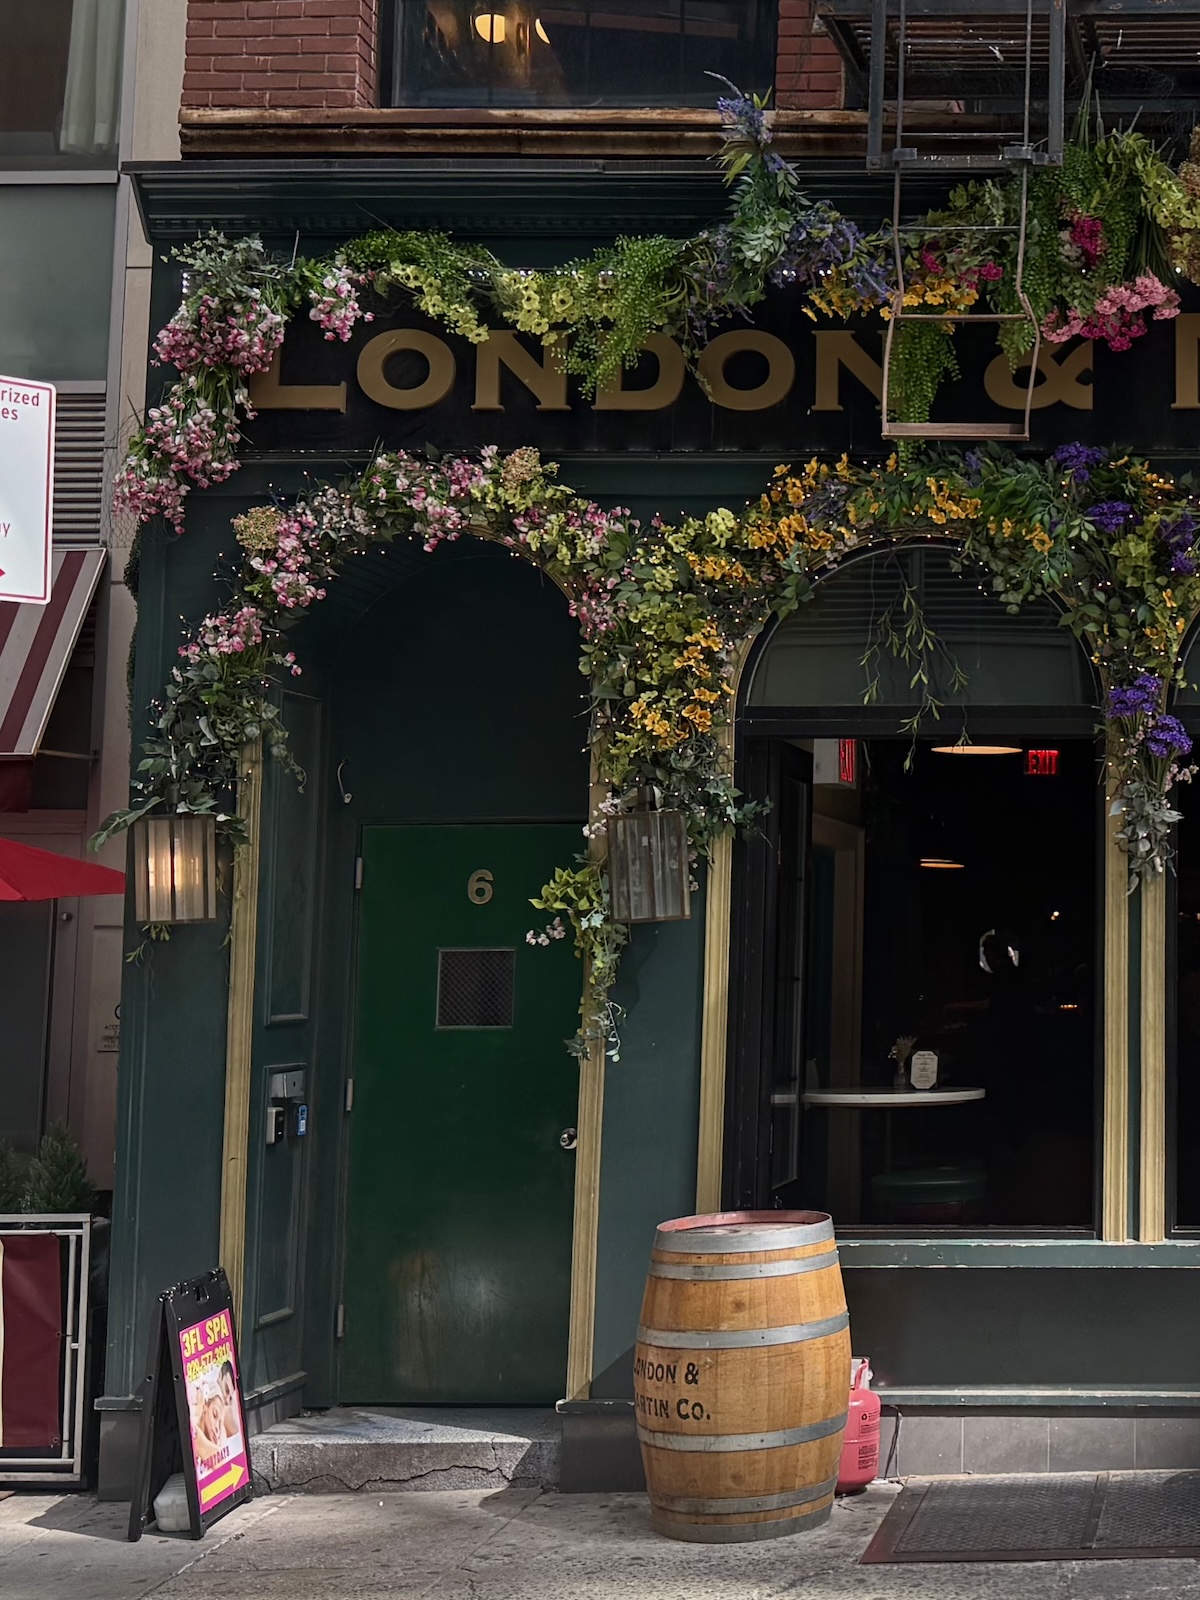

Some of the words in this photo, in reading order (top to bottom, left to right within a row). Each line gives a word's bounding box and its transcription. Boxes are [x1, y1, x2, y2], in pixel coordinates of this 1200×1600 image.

[248, 327, 899, 414] LONDON
[983, 340, 1094, 411] &
[1028, 749, 1059, 775] EXIT
[466, 869, 495, 905] 6
[205, 1313, 230, 1346] SPA
[684, 1362, 700, 1385] &
